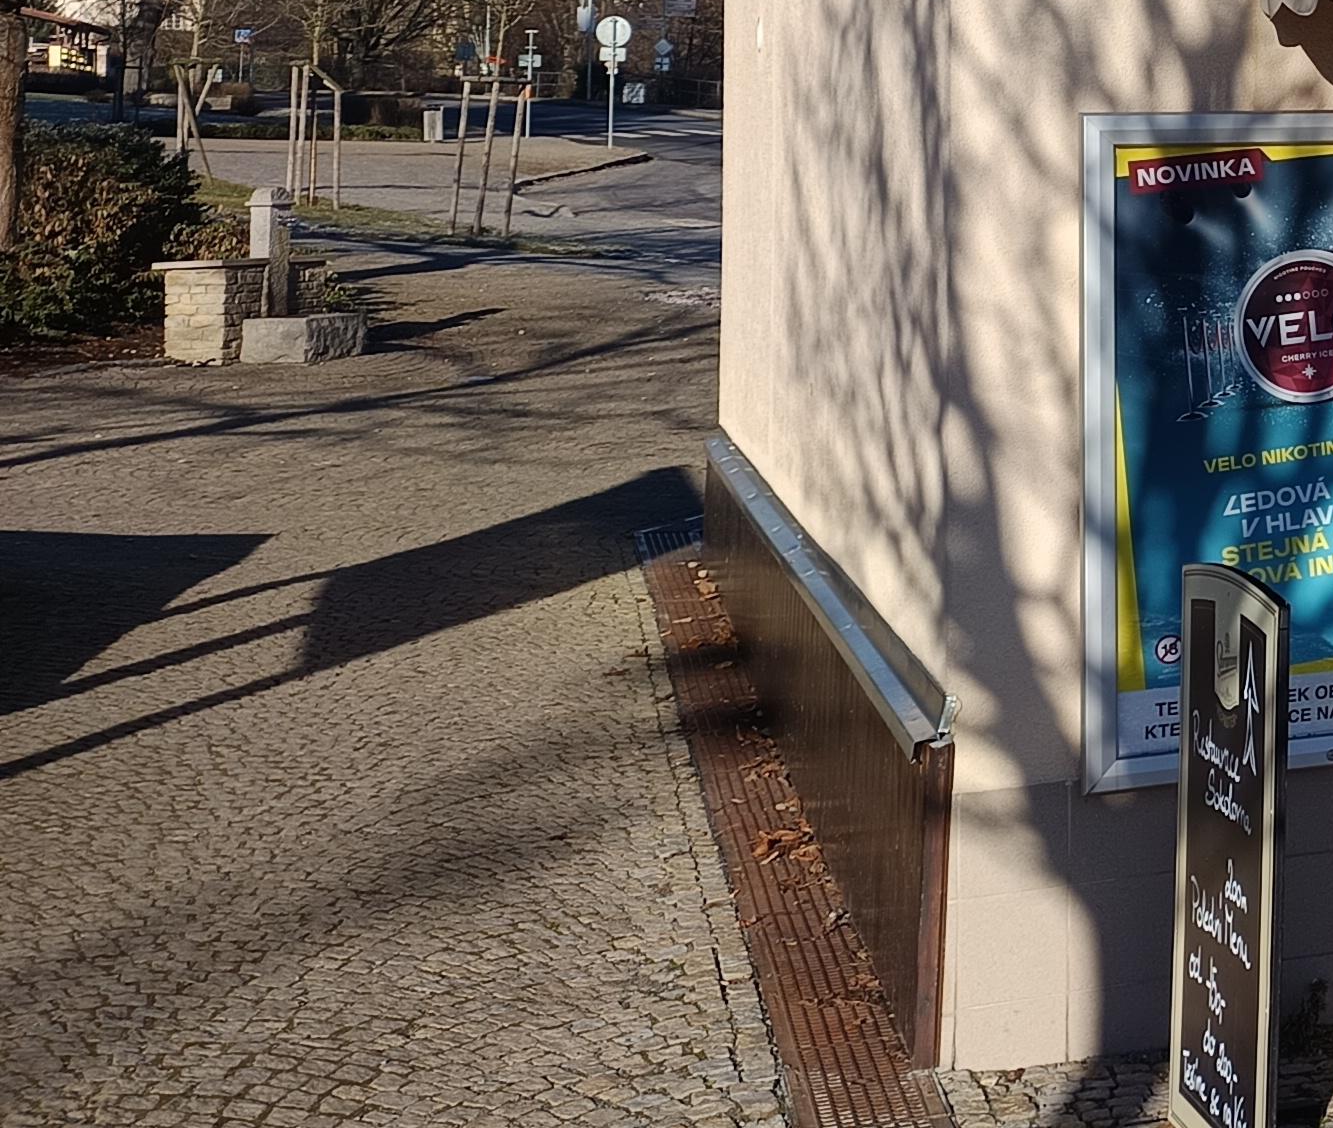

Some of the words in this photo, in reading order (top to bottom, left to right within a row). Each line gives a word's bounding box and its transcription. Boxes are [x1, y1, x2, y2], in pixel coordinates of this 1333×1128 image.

[1136, 158, 1256, 188] NOVINKA
[1281, 351, 1318, 364] CHERRY
[1204, 451, 1257, 474] VELO
[1222, 479, 1331, 516] LEDOVÁ
[1241, 517, 1260, 538] V
[1221, 525, 1331, 566] STEJNÁ
[1250, 555, 1303, 583] OVÁ
[1203, 1019, 1215, 1057] do
